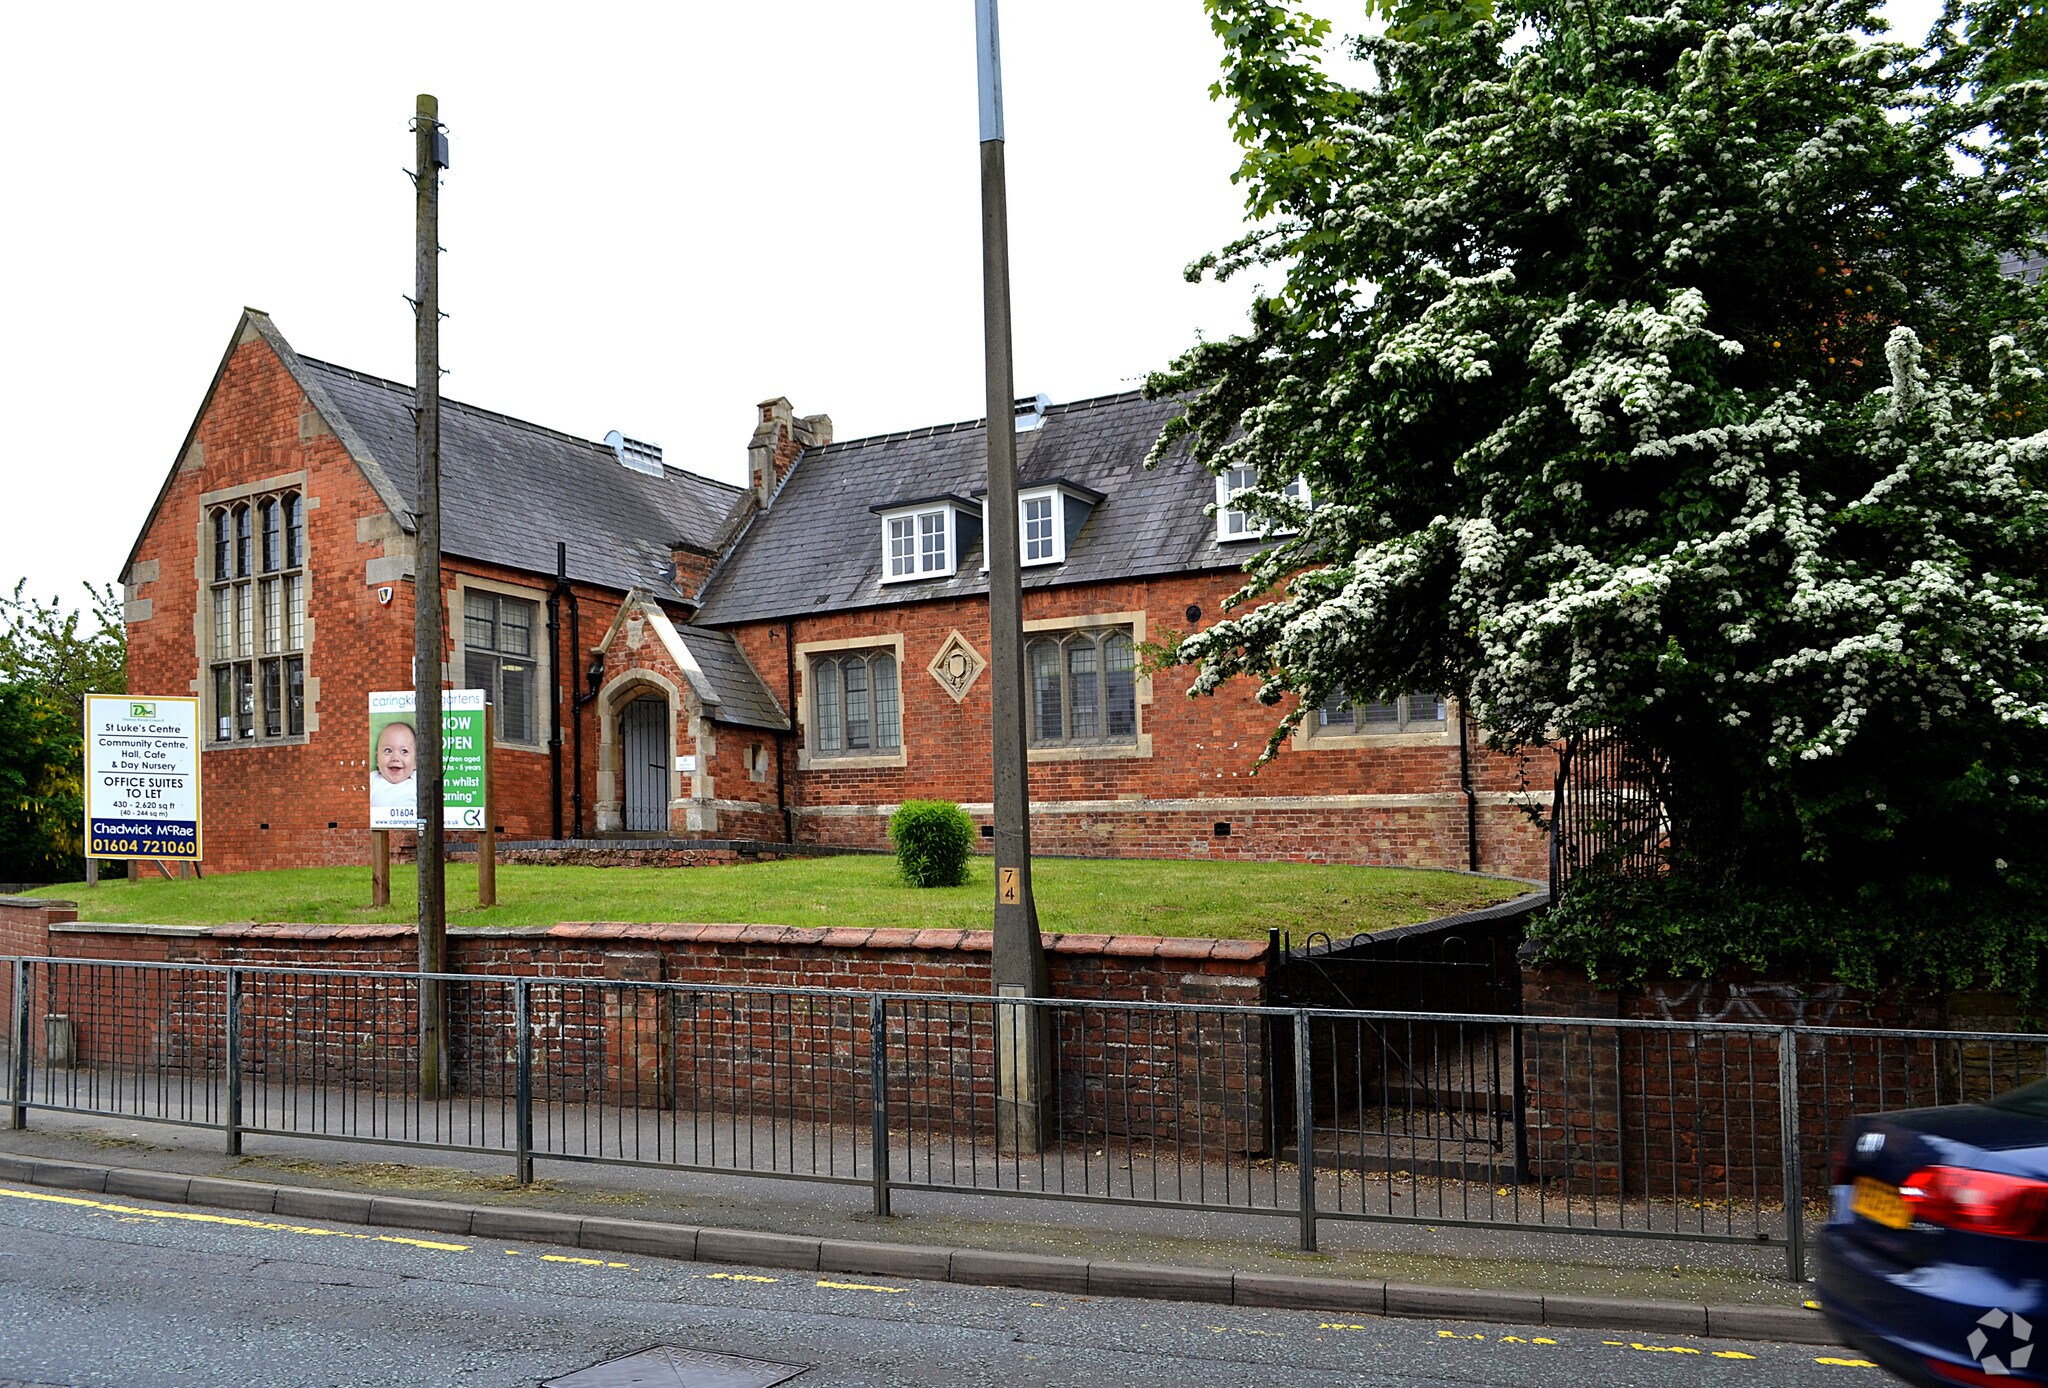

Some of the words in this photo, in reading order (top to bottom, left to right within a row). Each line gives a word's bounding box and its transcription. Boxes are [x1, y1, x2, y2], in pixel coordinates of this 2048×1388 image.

[105, 723, 114, 732] St
[117, 724, 146, 733] Luke's
[149, 725, 181, 734] Centre
[99, 739, 152, 749] Community
[155, 740, 188, 749] Centre,
[122, 750, 141, 759] Hall,
[144, 751, 166, 759] Cafe
[121, 761, 139, 770] Day
[142, 762, 176, 771] Nursery
[104, 777, 145, 788] OFFICE
[149, 778, 183, 788] SUITES
[452, 777, 479, 787] whilst
[126, 789, 141, 798] TO
[146, 789, 161, 799] LET
[390, 808, 414, 817] 01604
[94, 823, 152, 835] Chadwick
[157, 825, 194, 836] McRae
[93, 839, 138, 852] 01604
[143, 840, 195, 854] 721060
